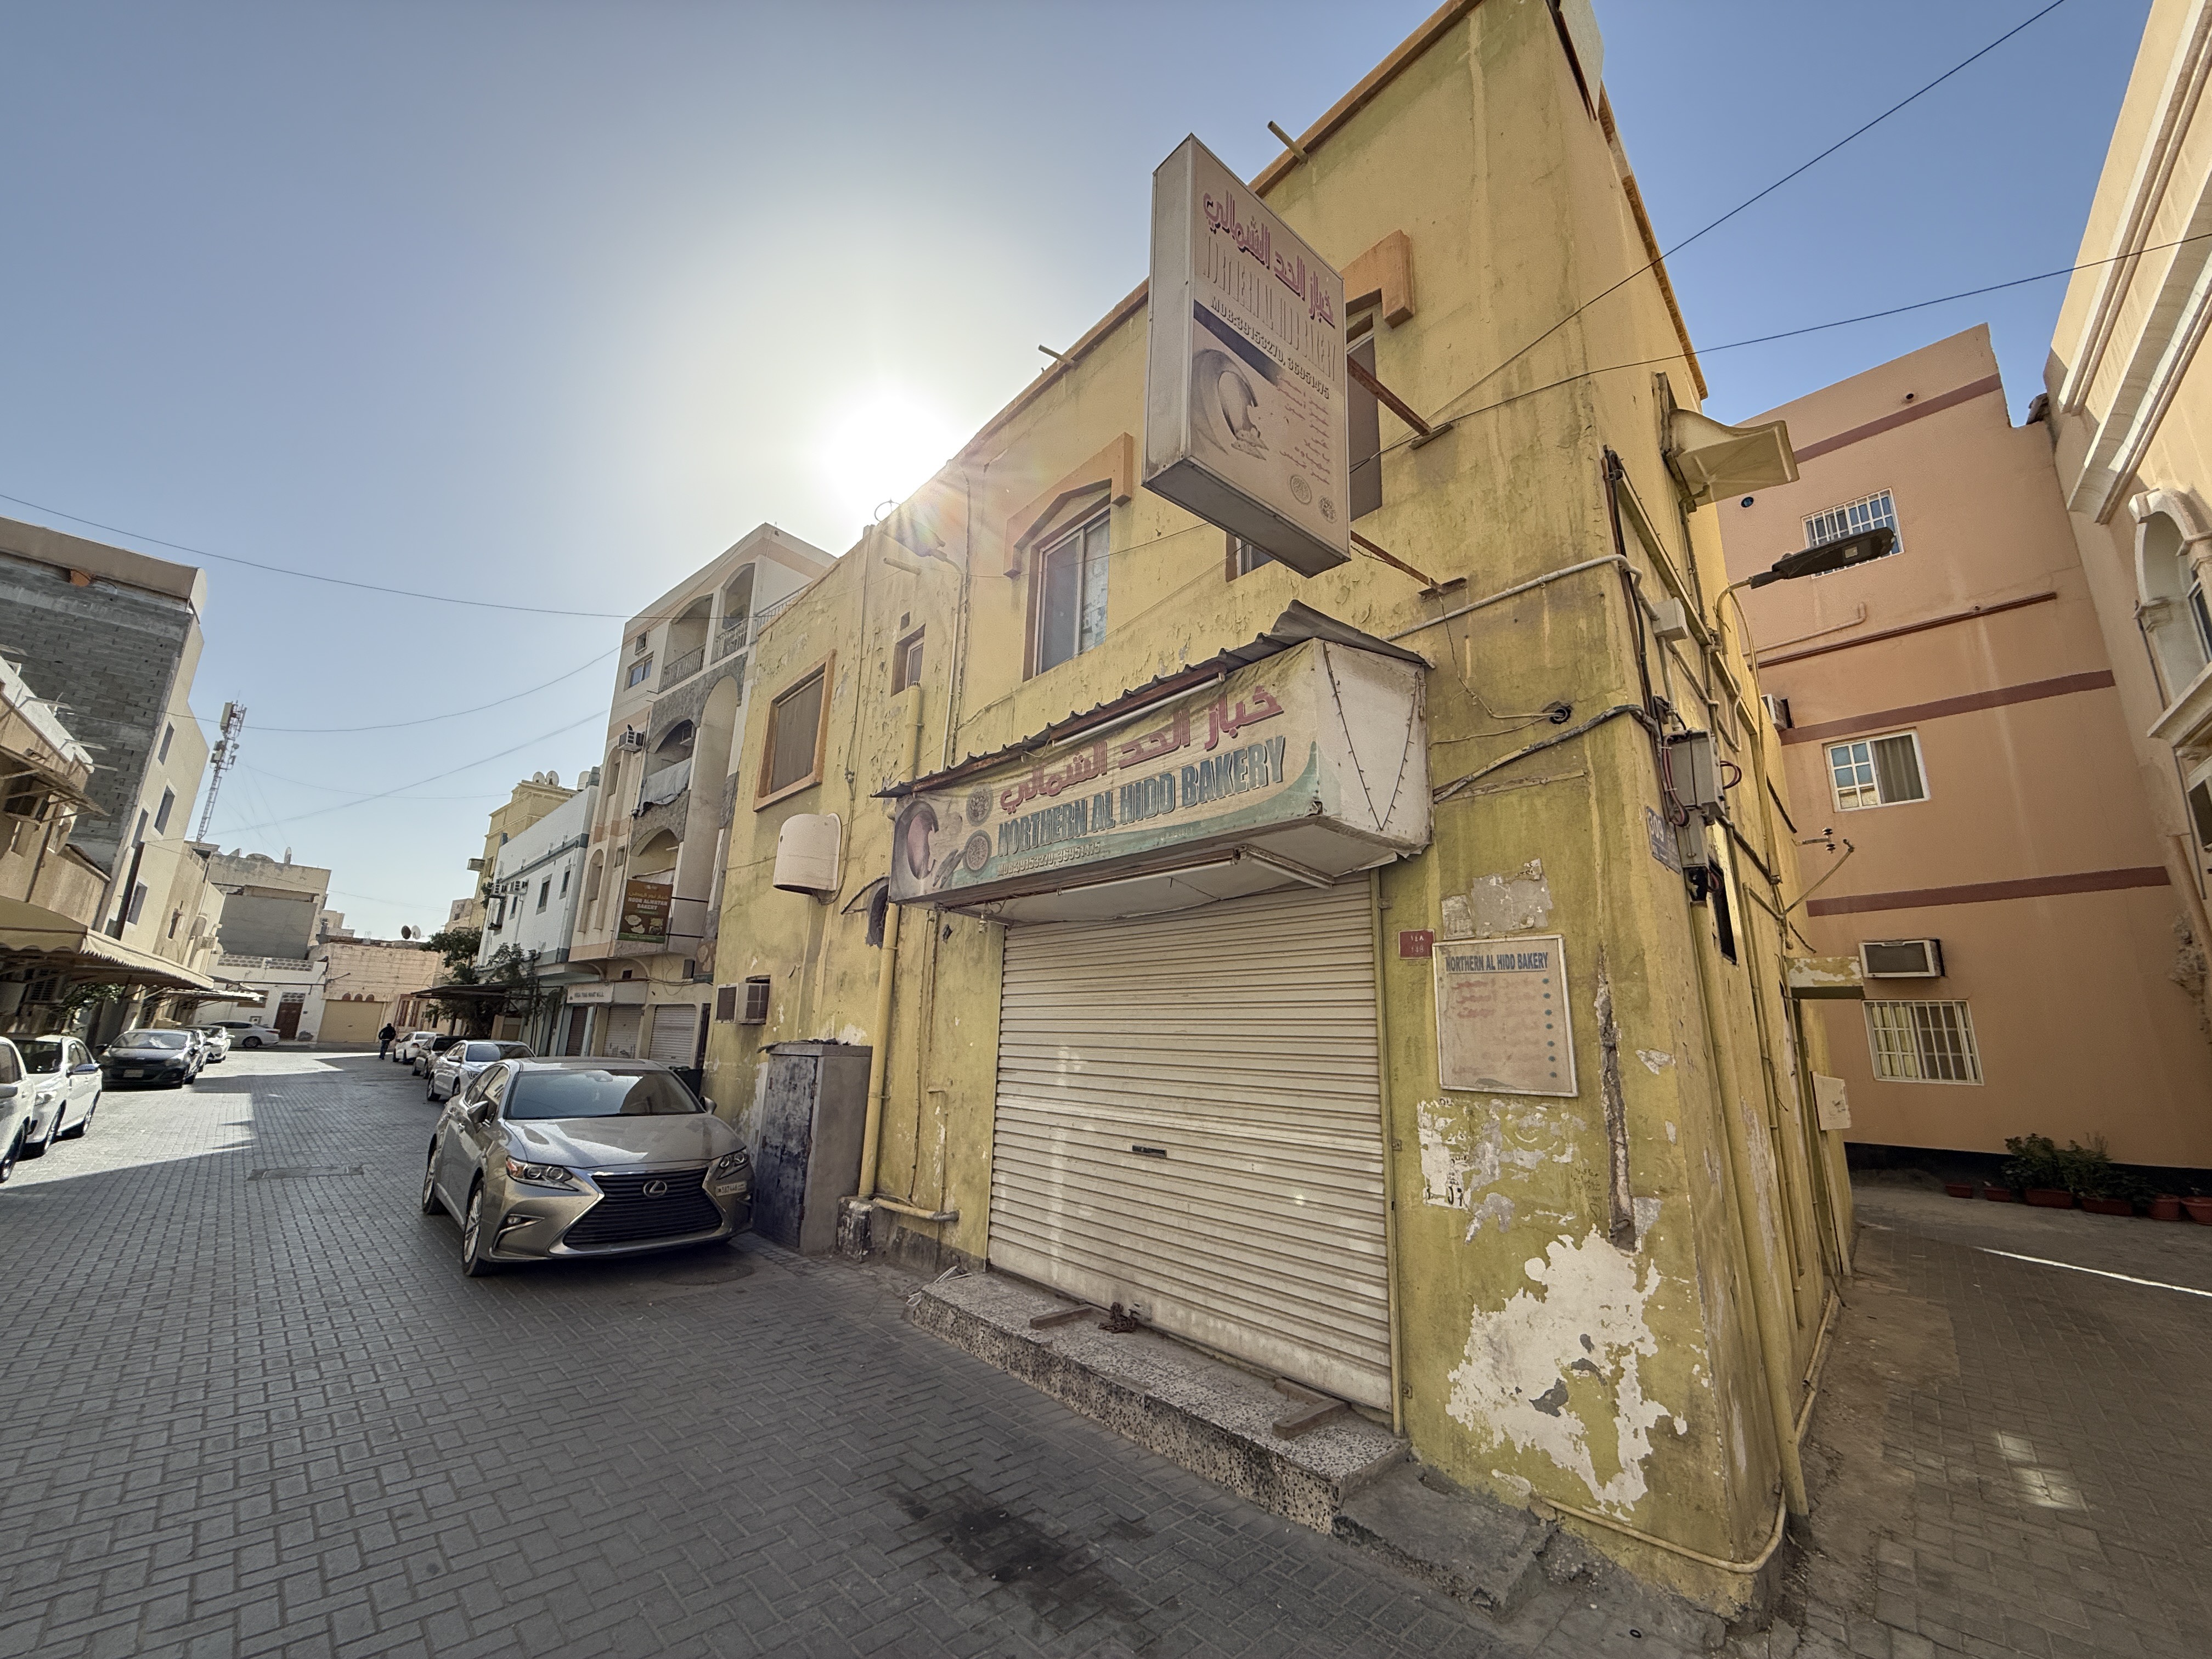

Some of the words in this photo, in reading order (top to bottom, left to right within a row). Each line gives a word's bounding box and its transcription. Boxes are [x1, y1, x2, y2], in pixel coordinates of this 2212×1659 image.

[1203, 189, 1271, 270] الشمالي
[1274, 250, 1305, 301] الحد
[1309, 271, 1336, 330] خباز
[1118, 707, 1190, 769] الحد
[1204, 685, 1284, 752] خباز
[998, 798, 1088, 857] NORTHERN
[1091, 791, 1115, 833] AL
[1120, 772, 1176, 825] HIDD
[1181, 736, 1286, 809] BAKERY
[1000, 739, 1108, 814] الشمالي
[1648, 811, 1664, 842] 309
[1446, 955, 1485, 972] NORTHERN
[1486, 955, 1496, 970] AL
[1497, 953, 1516, 970] HIDD
[1517, 952, 1549, 970] BAKERY
